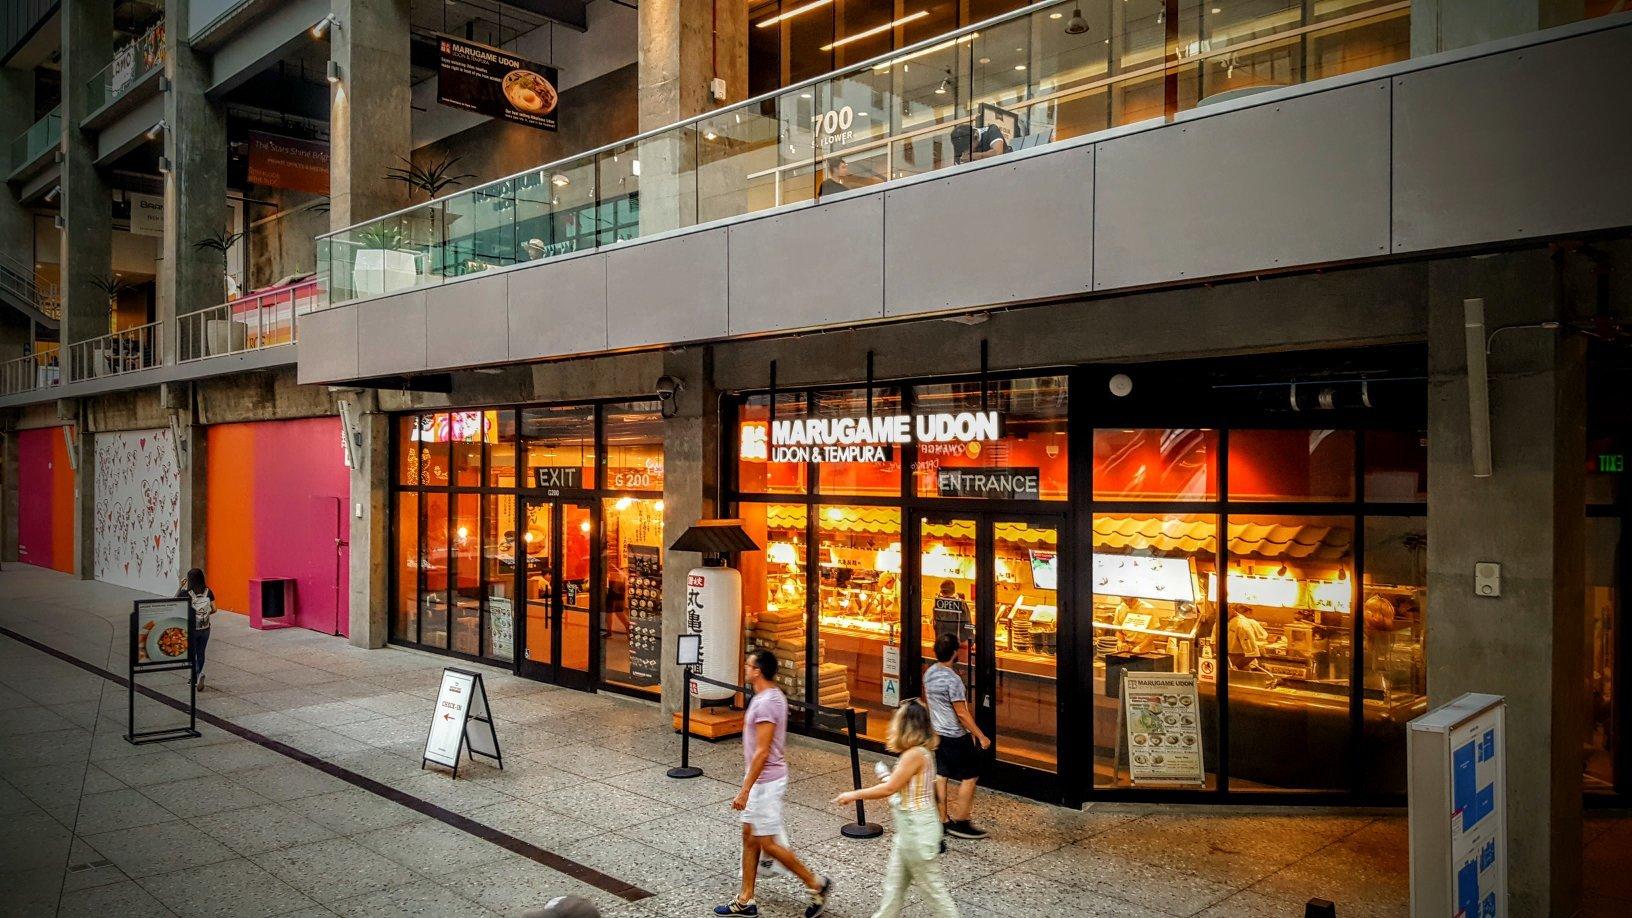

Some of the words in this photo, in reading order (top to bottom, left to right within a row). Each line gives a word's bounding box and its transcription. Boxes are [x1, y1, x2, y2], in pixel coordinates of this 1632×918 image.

[452, 43, 498, 63] MARUGAME
[498, 57, 520, 69] UDON
[811, 106, 853, 138] 700
[772, 415, 911, 445] MARUGAME
[916, 411, 999, 443] UDON
[772, 447, 809, 463] UDON
[811, 447, 822, 463] &
[823, 446, 886, 463] TEMPURA
[539, 468, 576, 487] EXIT
[615, 475, 624, 487] G
[625, 474, 650, 487] 200
[938, 474, 1038, 493] ENTRANCE
[936, 599, 960, 610] OPEN
[885, 679, 895, 694] A
